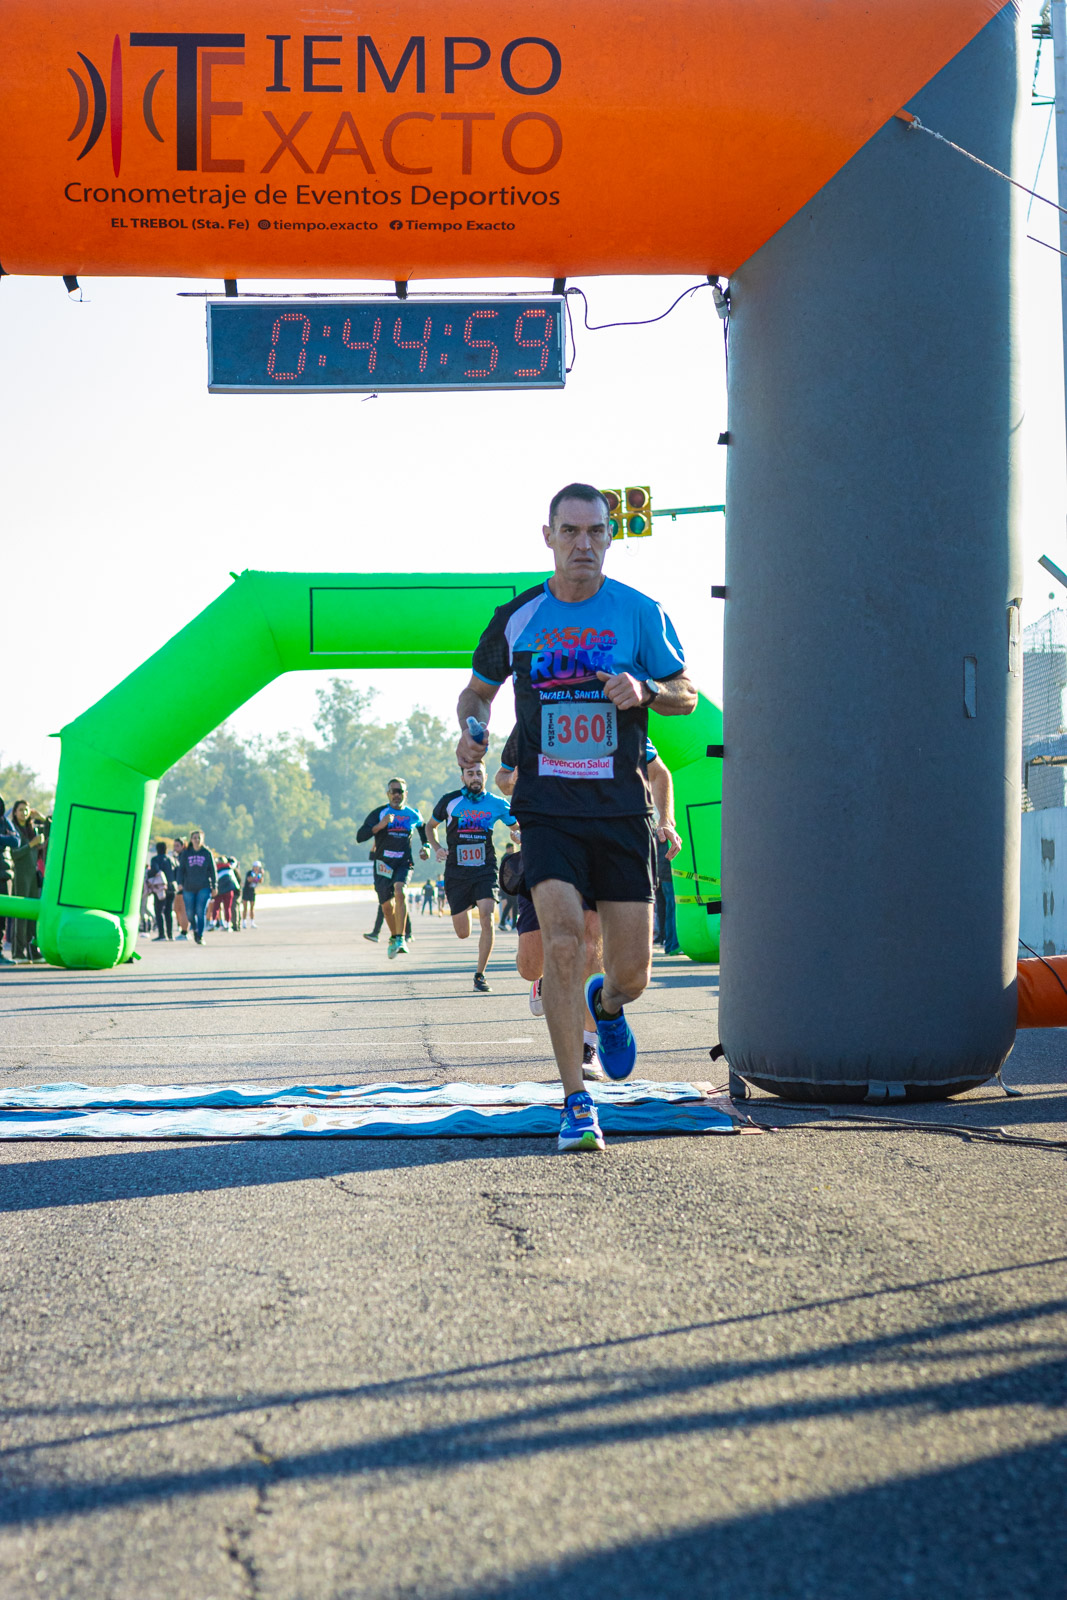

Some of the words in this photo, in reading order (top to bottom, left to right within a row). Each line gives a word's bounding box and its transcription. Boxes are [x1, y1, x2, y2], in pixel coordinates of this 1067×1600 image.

[64, 182, 247, 209] Cronometraje
[254, 184, 288, 205] de
[296, 184, 402, 206] Eventos
[411, 185, 560, 210] Deportivos
[111, 218, 128, 228] EL
[130, 218, 188, 229] TREBOL
[192, 218, 225, 231] (Sta.
[228, 219, 250, 231] Fe)
[273, 219, 378, 232] tiempo.exacto
[405, 219, 463, 232] Tiempo
[466, 220, 516, 231] Exacto
[267, 309, 553, 380] 0:44:59
[574, 689, 600, 700] SANTA
[547, 712, 555, 747] TIEMPO
[557, 713, 606, 744] 360
[587, 759, 610, 769] Salud
[462, 848, 481, 861] 310
